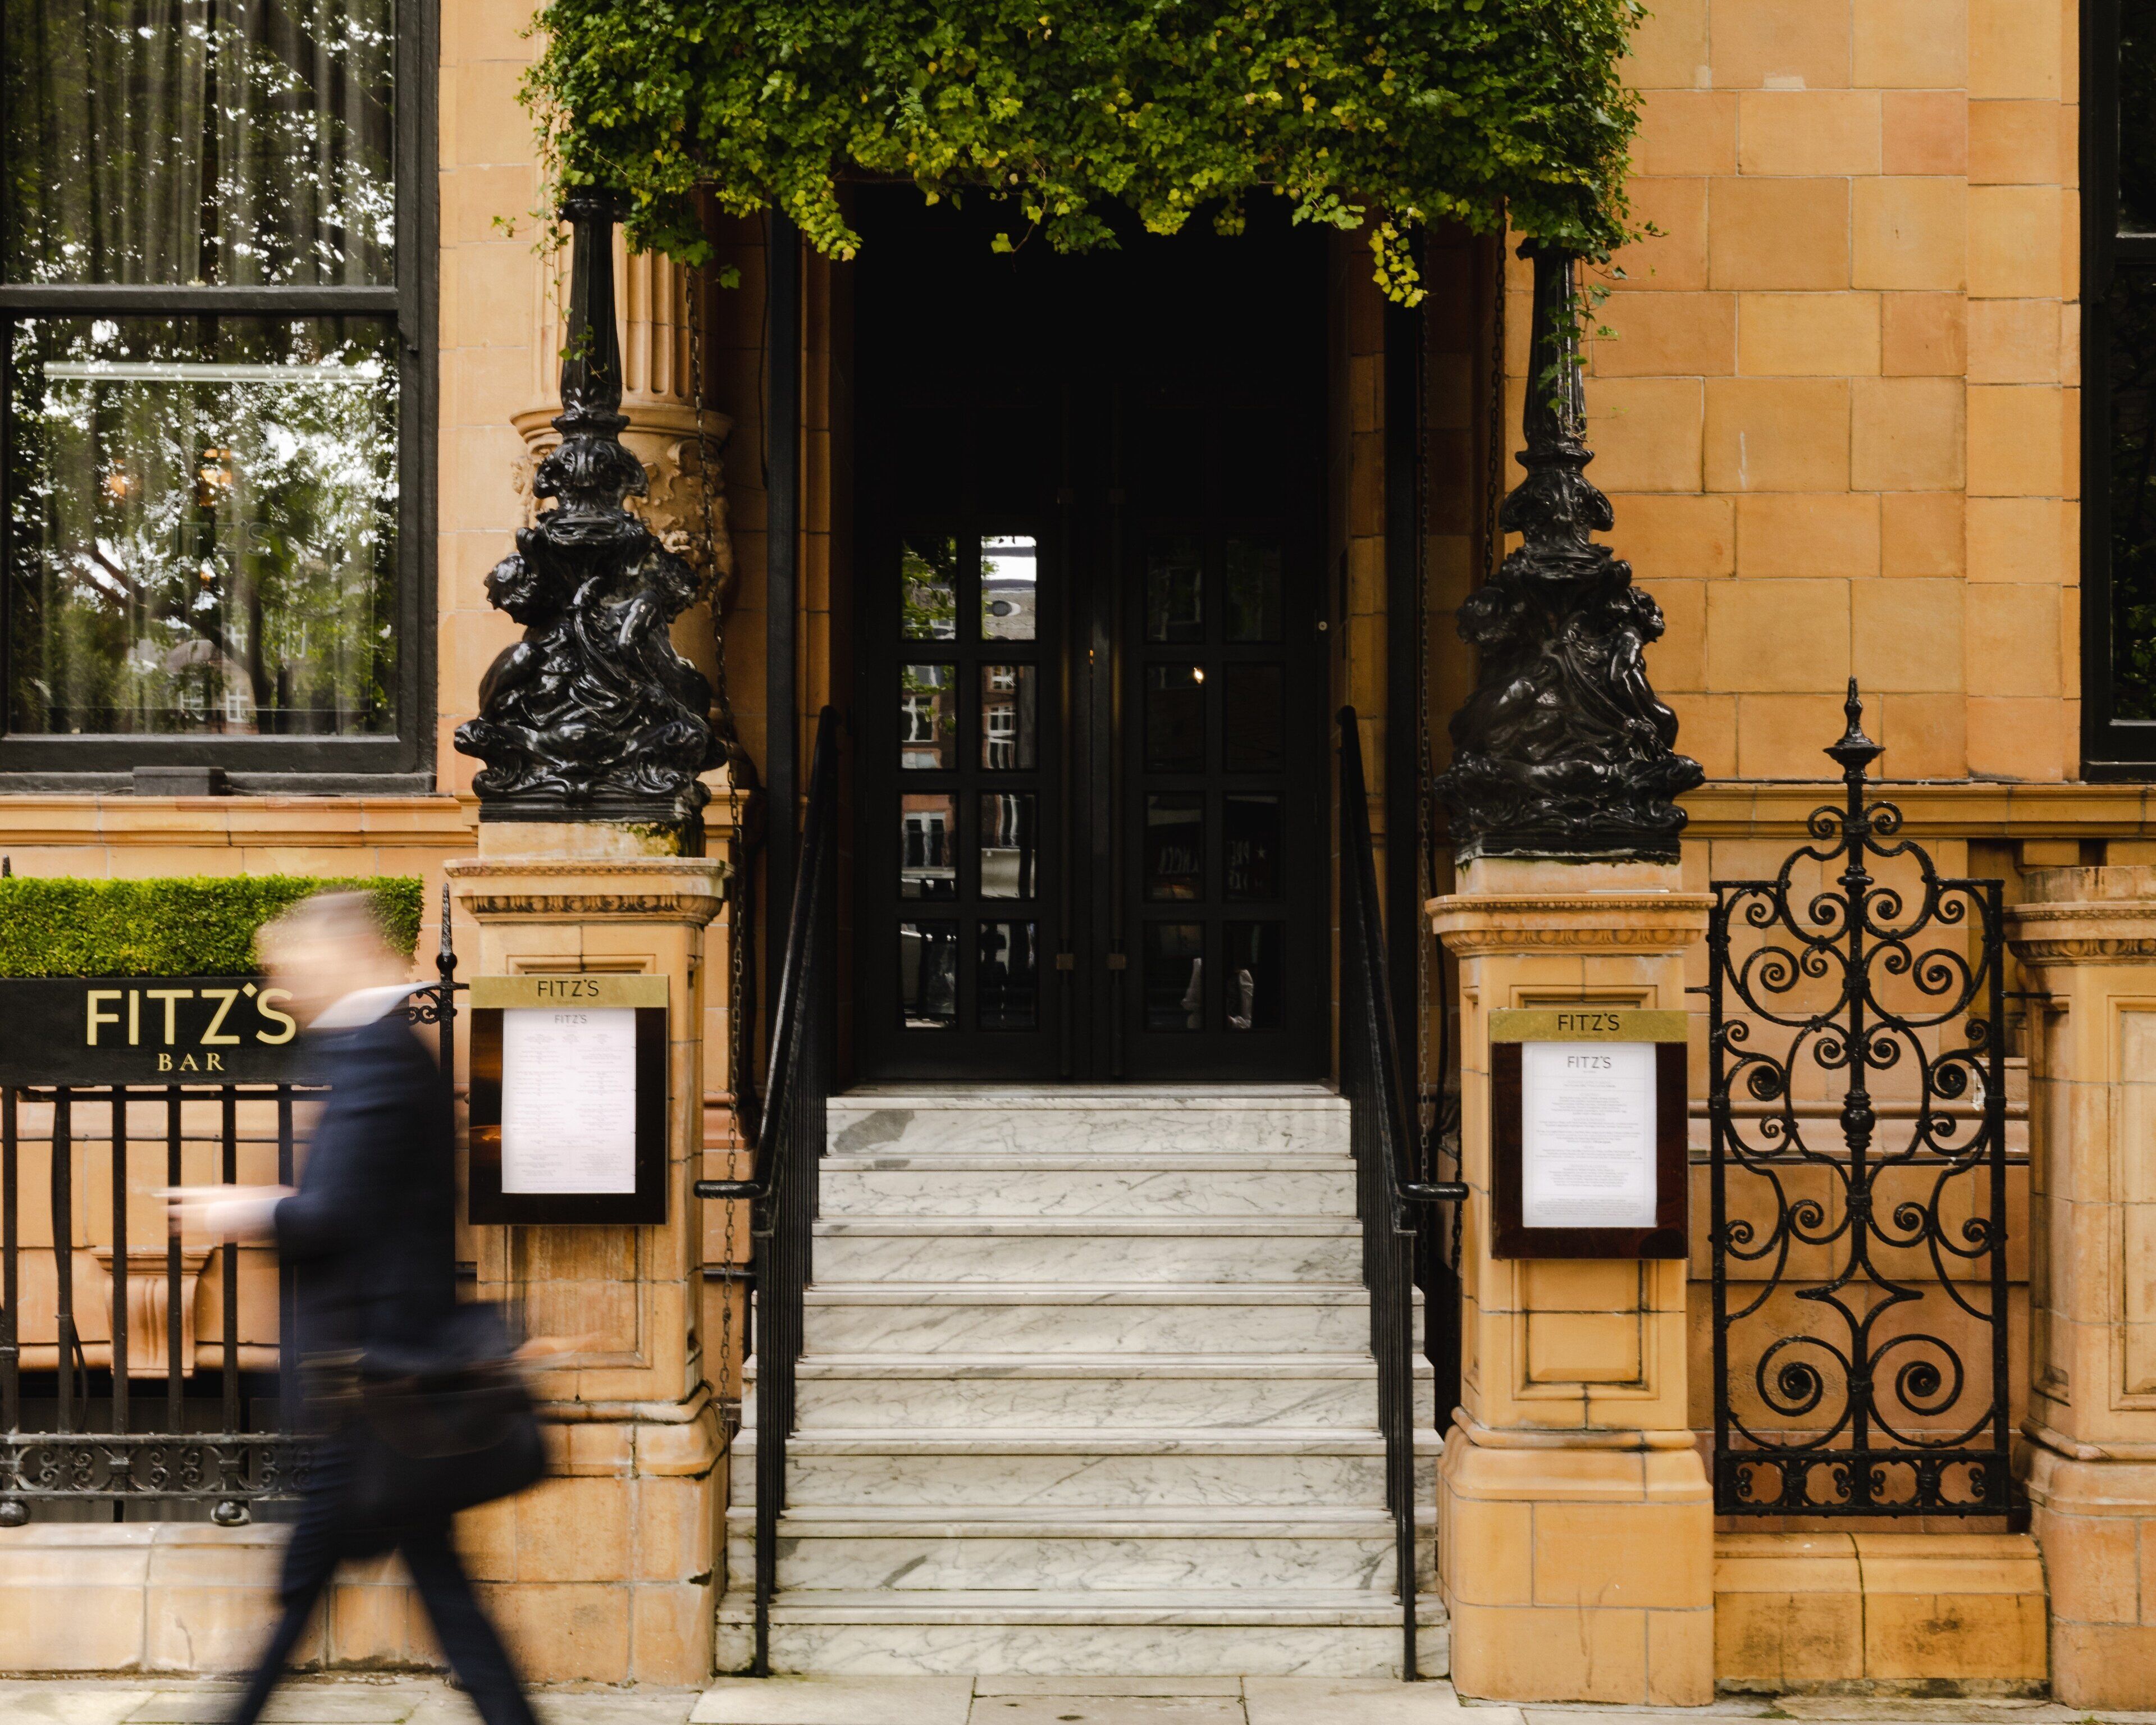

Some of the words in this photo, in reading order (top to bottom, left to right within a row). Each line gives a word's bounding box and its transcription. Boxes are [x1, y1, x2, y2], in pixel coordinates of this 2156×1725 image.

[537, 979, 599, 997] FITZ'S
[87, 983, 296, 1046] FITZ'S
[554, 1014, 587, 1024] FITZ'S
[1557, 1012, 1620, 1032] FITZ'S
[158, 1053, 225, 1071] BAR
[1567, 1056, 1612, 1069] FITZ'S
